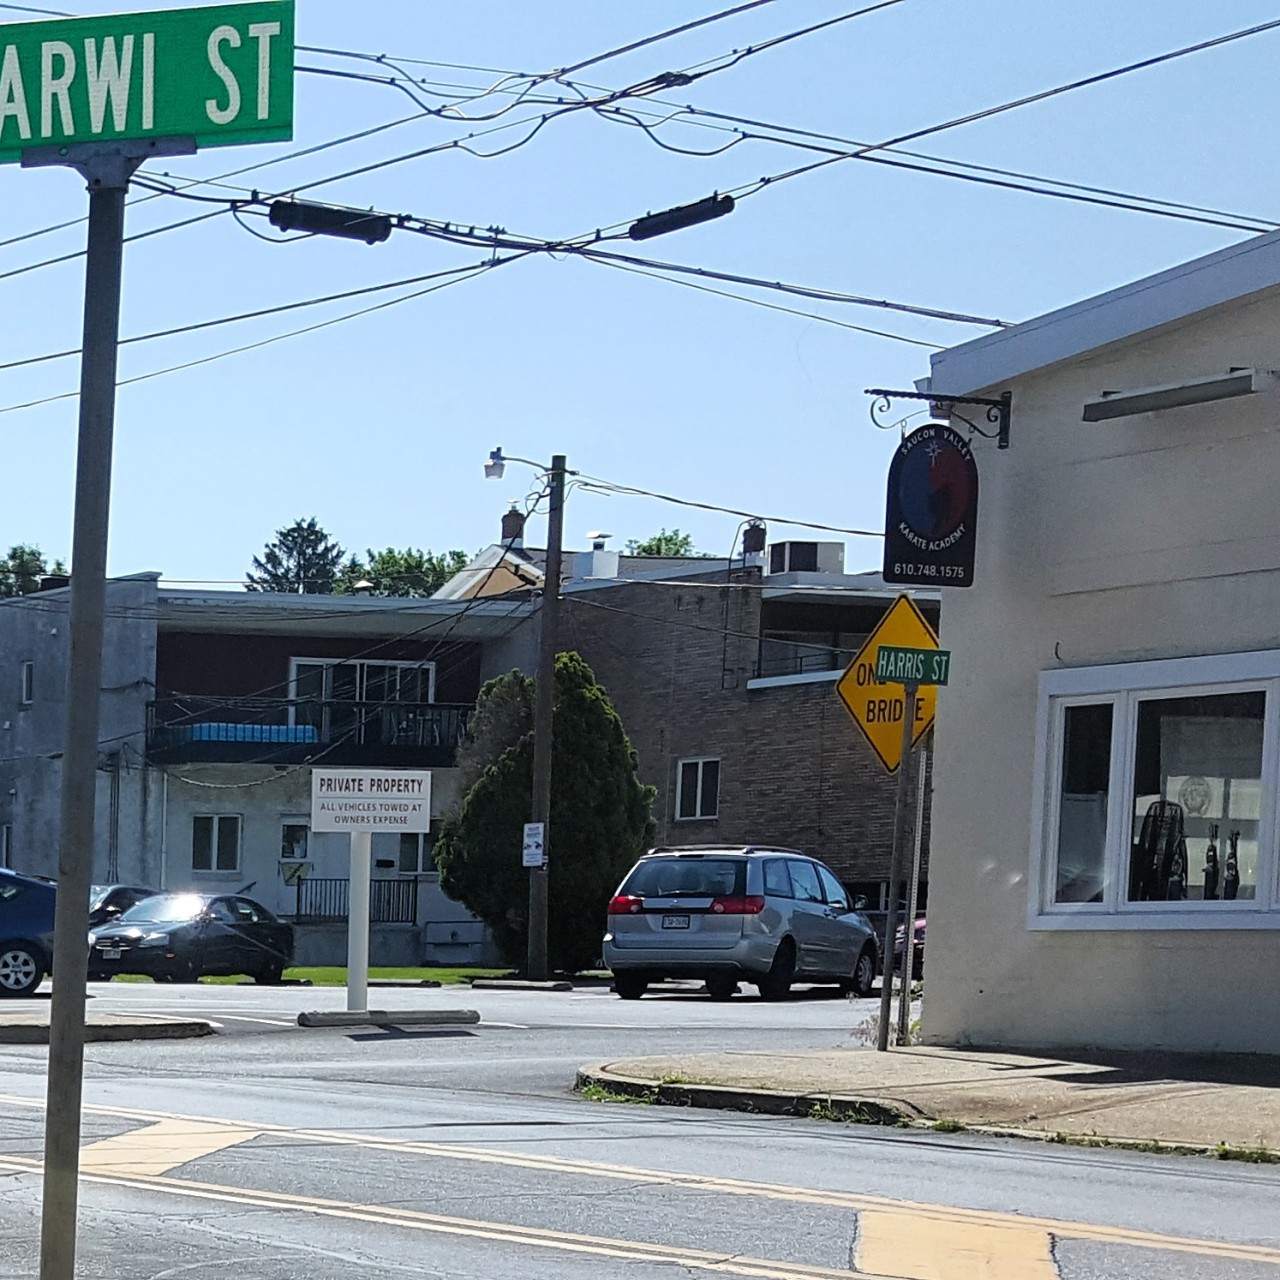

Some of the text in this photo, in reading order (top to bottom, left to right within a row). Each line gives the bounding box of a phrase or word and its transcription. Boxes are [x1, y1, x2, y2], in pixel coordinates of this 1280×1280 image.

[205, 21, 281, 125] ST
[901, 428, 972, 461] SAUCON VALLEY
[898, 521, 966, 551] KARATE ACADEMY
[894, 563, 964, 578] 610.748.1575
[856, 662, 887, 687] ON
[877, 651, 948, 681] HARRIS ST
[866, 698, 925, 723] BRIDE
[320, 778, 424, 793] PRIVATE PROPERTY
[320, 803, 422, 812] ALL VEHICLES TOWED AT
[334, 815, 408, 824] OWNERS EXPENSE
